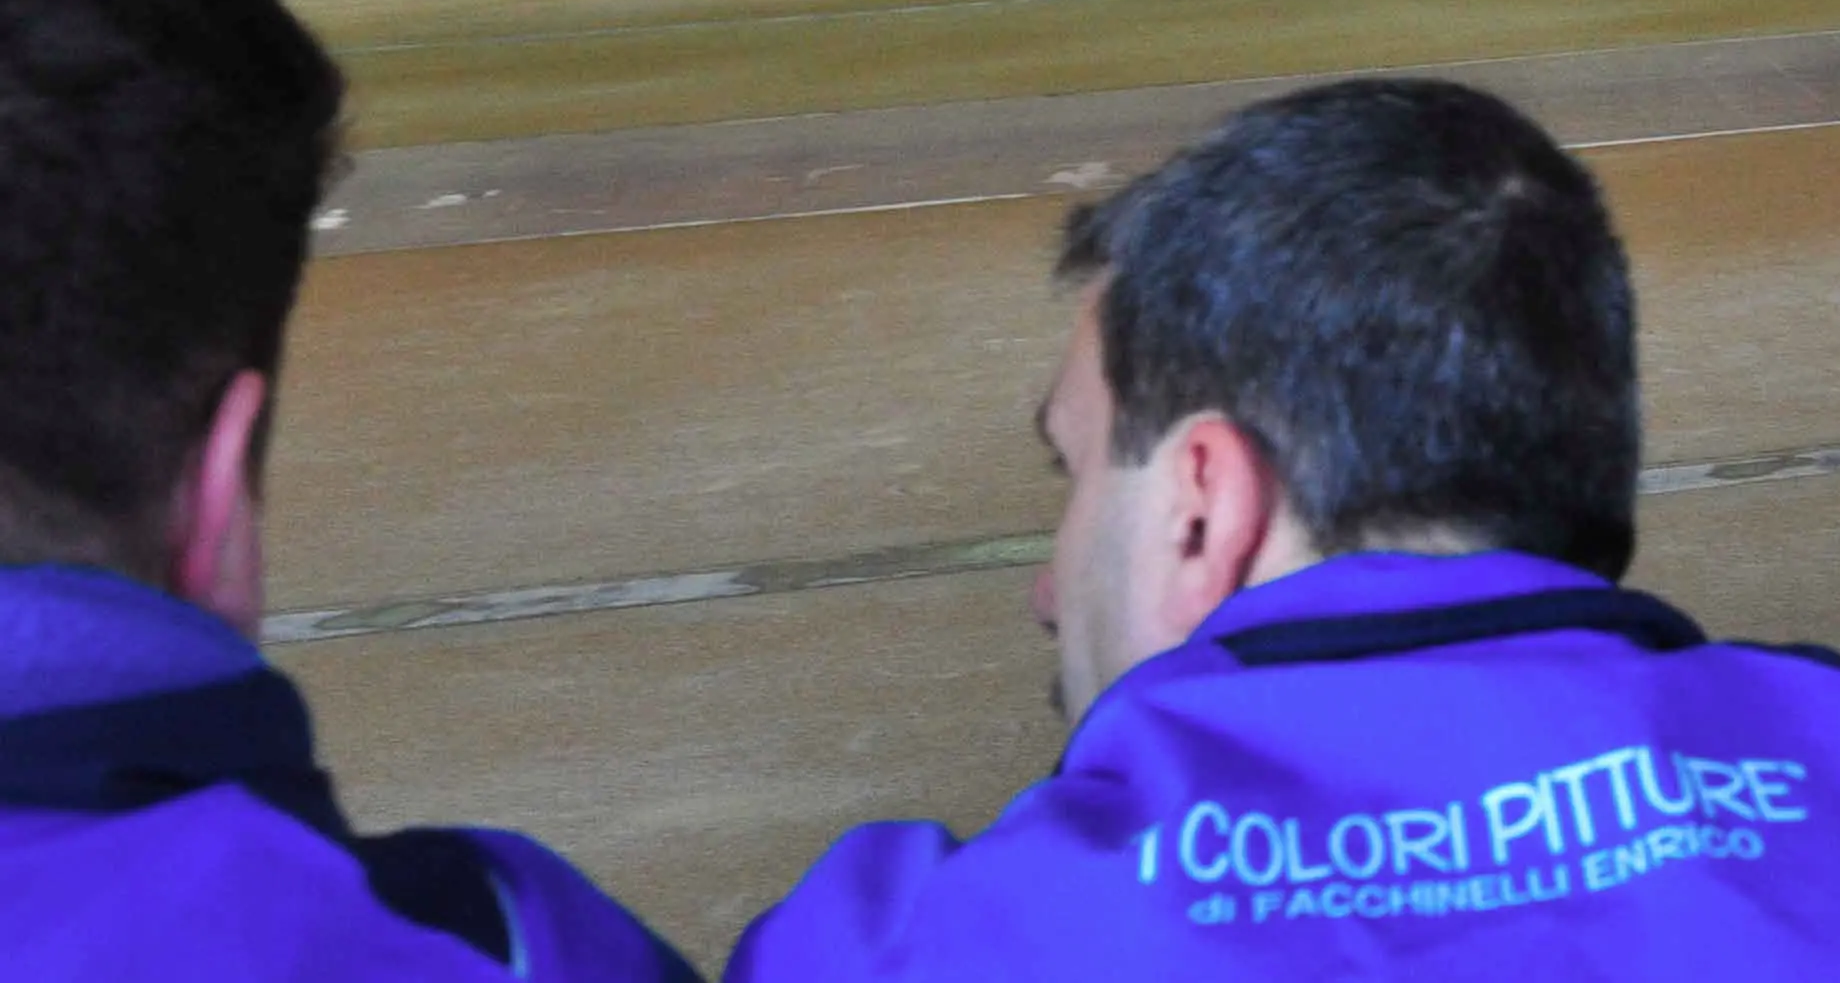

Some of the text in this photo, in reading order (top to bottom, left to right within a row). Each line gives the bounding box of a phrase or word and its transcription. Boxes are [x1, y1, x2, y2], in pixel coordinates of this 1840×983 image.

[1179, 801, 1470, 886] COLORI
[1188, 825, 1764, 924] di FACCHINELLI ENRICO
